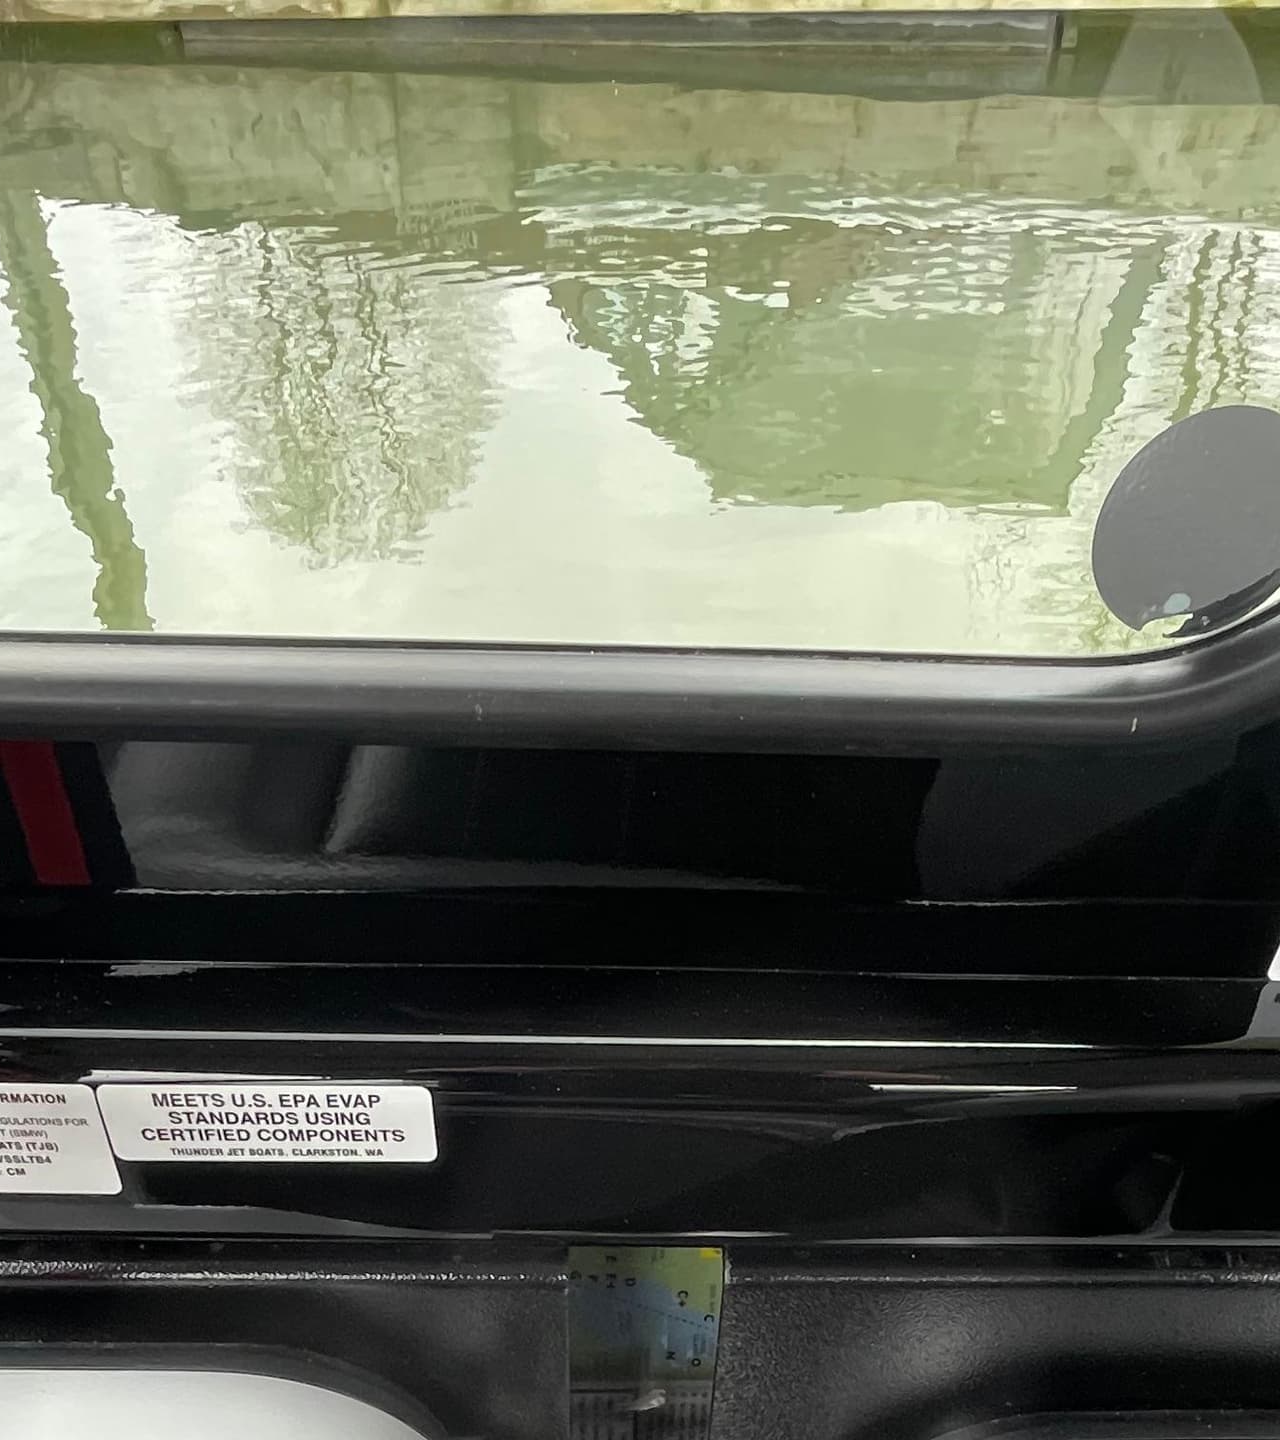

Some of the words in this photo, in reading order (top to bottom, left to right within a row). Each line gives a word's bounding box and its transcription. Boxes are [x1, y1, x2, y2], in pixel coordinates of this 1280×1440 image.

[151, 1093, 222, 1107] MEETS
[231, 1093, 272, 1107] U.S.
[278, 1094, 321, 1108] EPA
[326, 1094, 381, 1108] EVAP
[64, 1118, 89, 1126] FOR
[169, 1111, 299, 1125] STANDARDS
[305, 1112, 371, 1126] USING
[141, 1128, 250, 1142] CERTIFIED
[256, 1129, 406, 1143] COMPONENTS
[170, 1147, 224, 1156] THUNDER
[226, 1147, 245, 1156] JET
[365, 1148, 384, 1157] WA
[6, 1167, 27, 1176] CM
